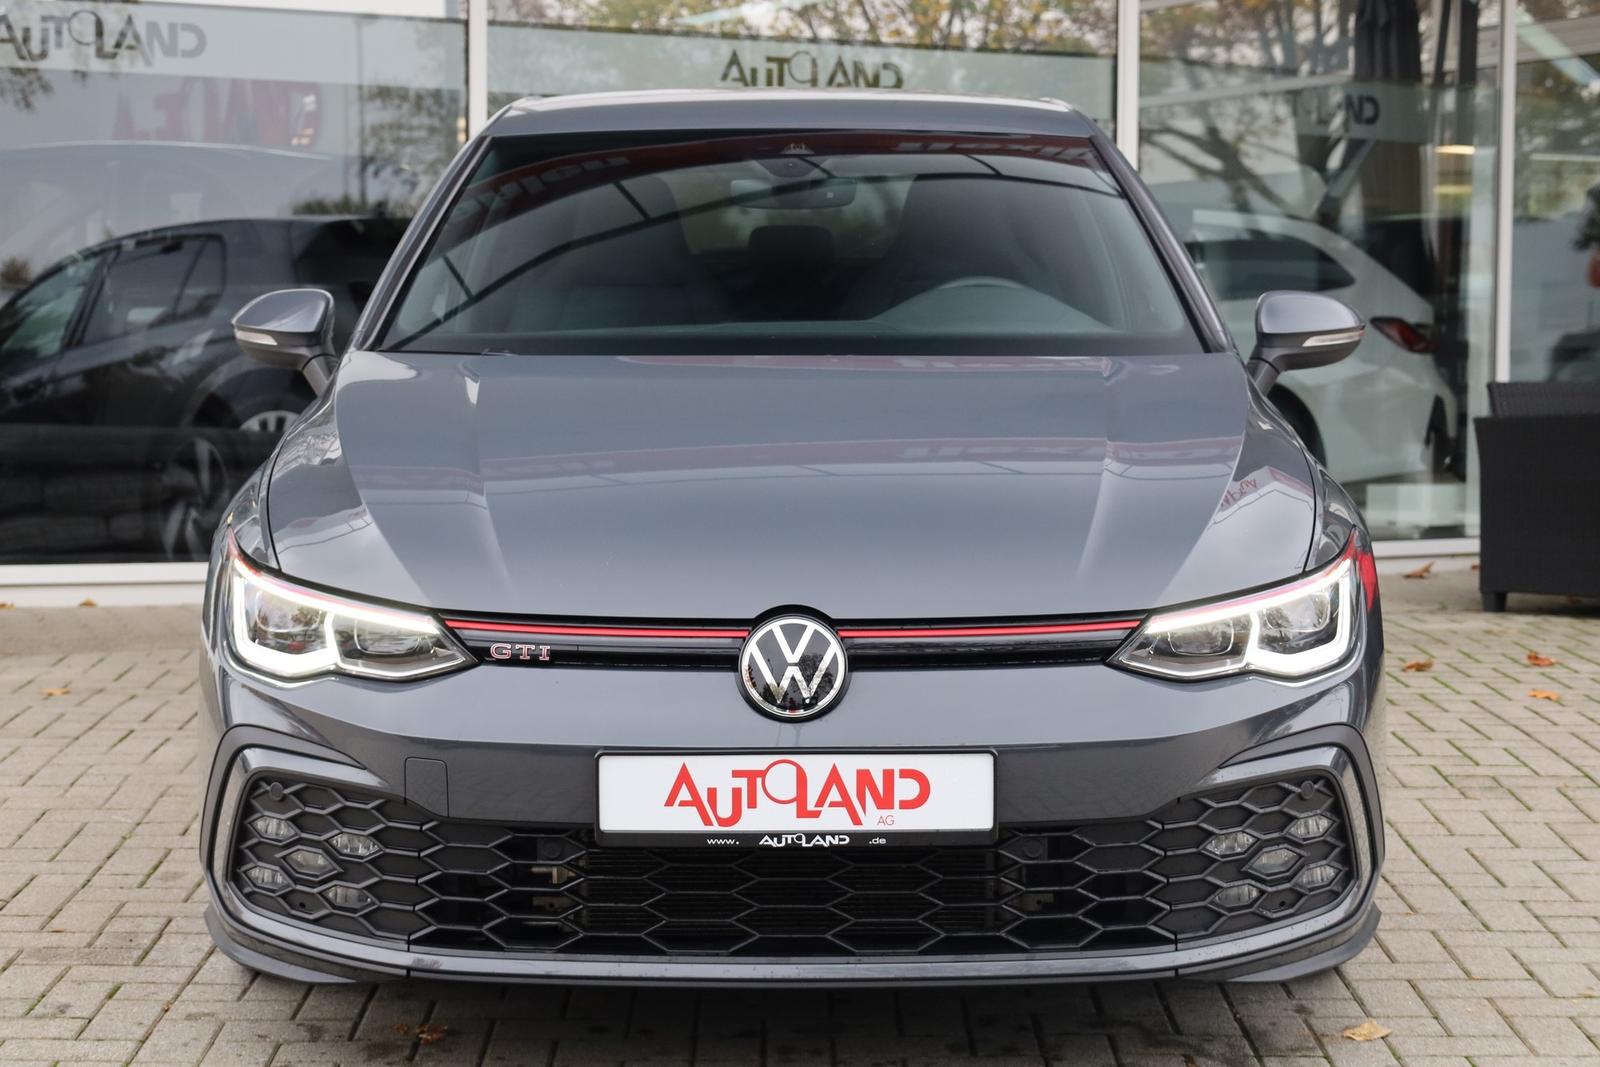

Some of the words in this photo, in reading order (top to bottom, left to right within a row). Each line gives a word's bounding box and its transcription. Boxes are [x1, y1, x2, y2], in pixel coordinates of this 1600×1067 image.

[490, 642, 551, 661] GTI
[664, 758, 931, 828] AUTOLAND
[876, 815, 895, 826] AG
[759, 833, 850, 848] AUTOLAND
[869, 836, 887, 845] .de
